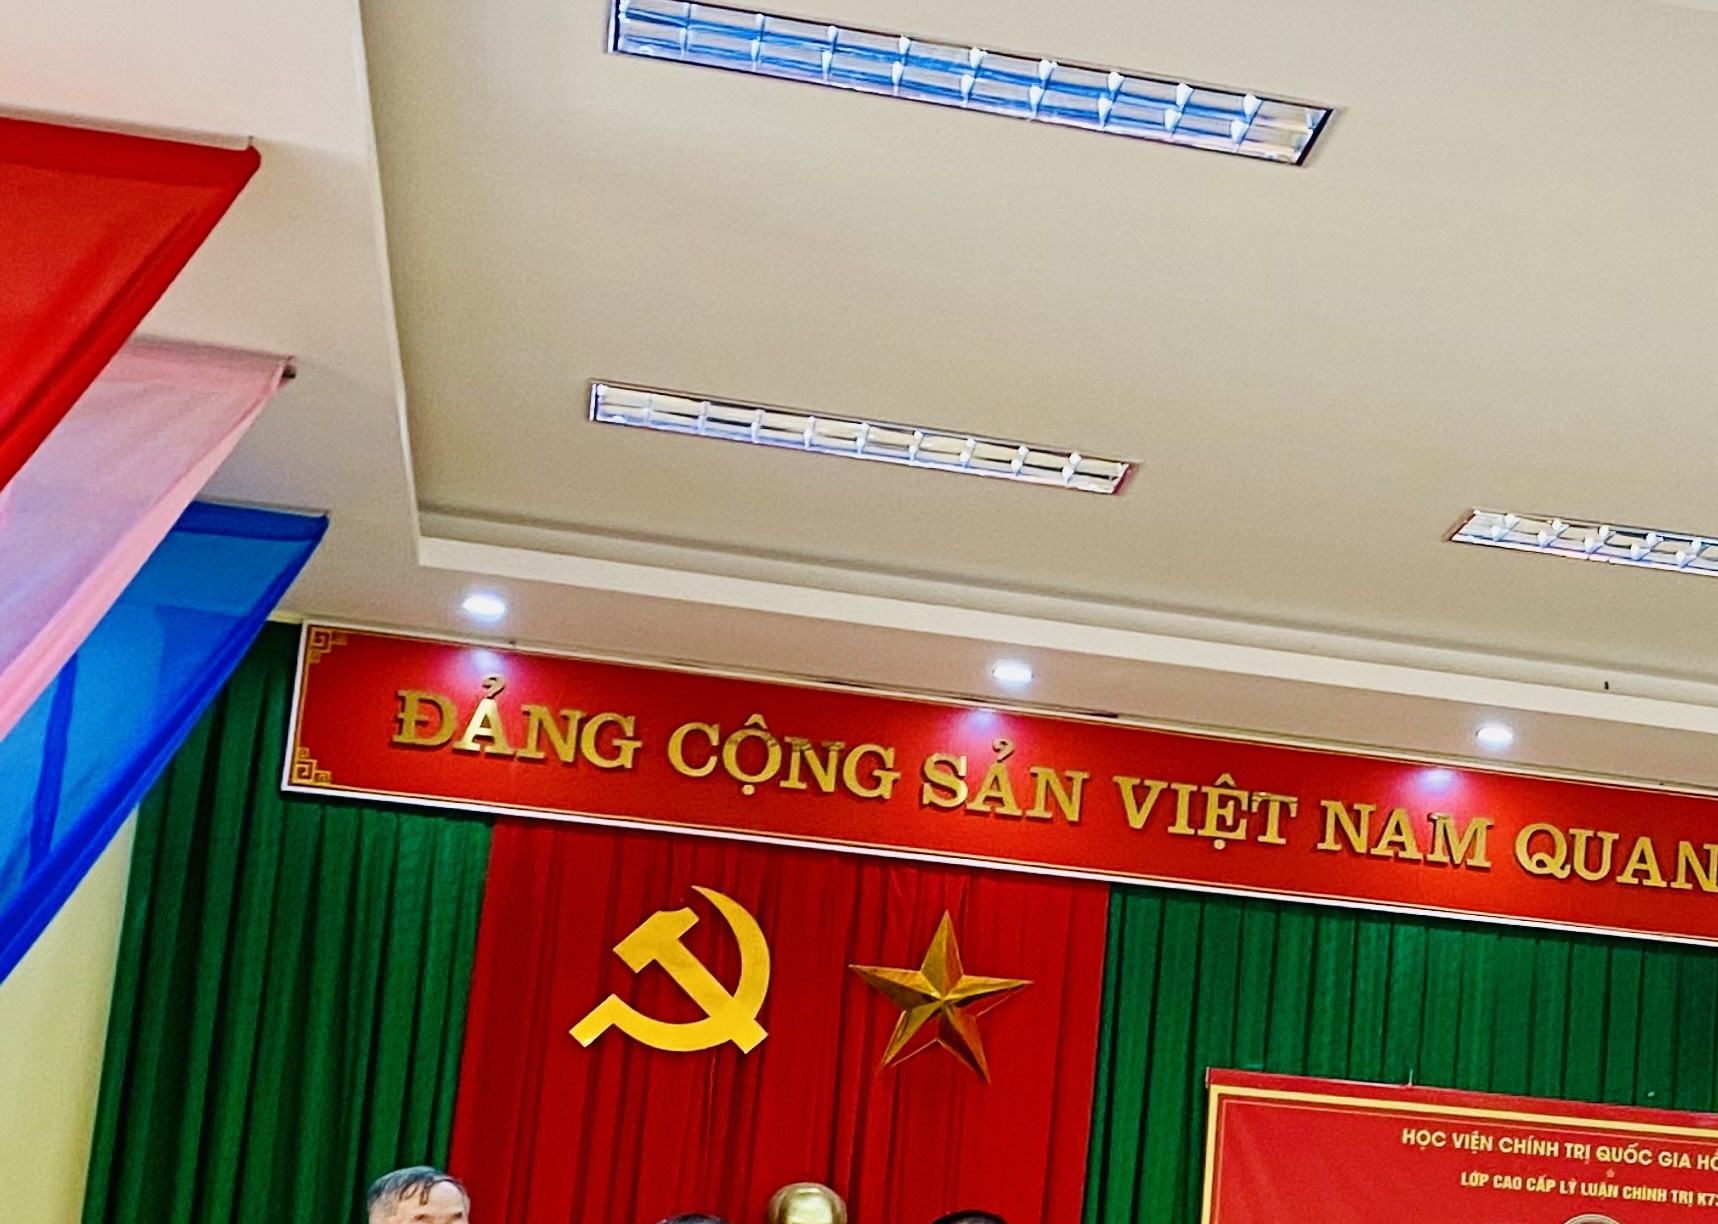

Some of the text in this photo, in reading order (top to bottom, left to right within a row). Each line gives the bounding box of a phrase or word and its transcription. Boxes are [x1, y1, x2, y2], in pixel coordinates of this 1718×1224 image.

[392, 673, 643, 769] ĐẢNG
[666, 713, 901, 800] CỘNG
[920, 737, 1090, 823] SẢN
[1112, 773, 1298, 850] VIỆT
[1317, 800, 1492, 869] NAM
[1402, 1127, 1447, 1151] HỌC
[1452, 1130, 1494, 1154] VIỆN
[1498, 1135, 1559, 1157] CHÍNH
[1564, 1142, 1592, 1164] TRỊ
[1596, 1143, 1652, 1165] QUỐC
[1658, 1151, 1692, 1169] GIA
[1460, 1170, 1489, 1187] LỚP
[1493, 1174, 1522, 1190] CAO
[1526, 1174, 1556, 1192] CẤP
[1581, 1181, 1619, 1200] LUẬN
[1622, 1185, 1667, 1202] CHÍNH
[1670, 1189, 1694, 1207] TRỊ
